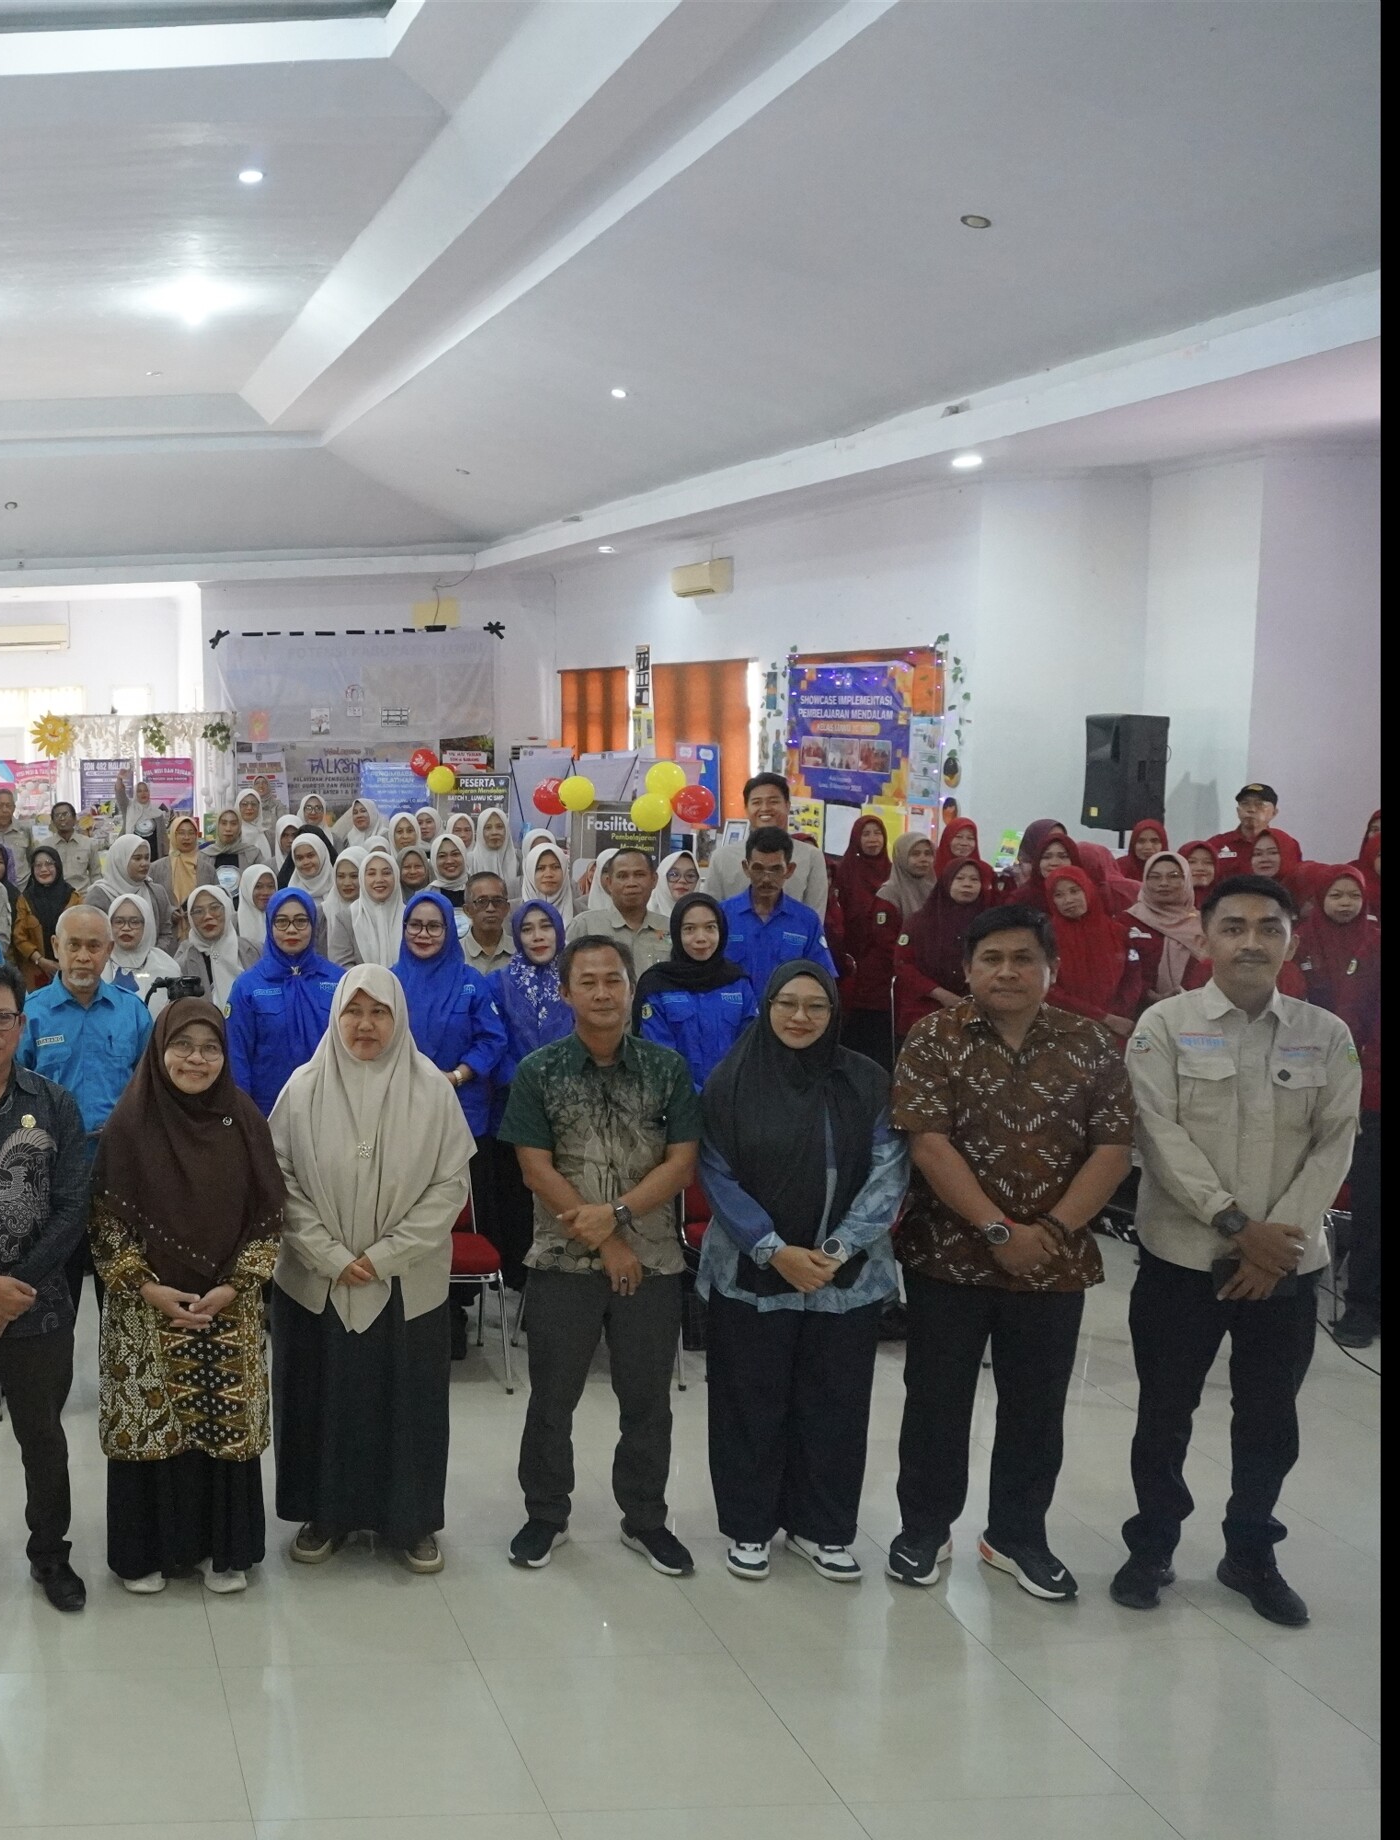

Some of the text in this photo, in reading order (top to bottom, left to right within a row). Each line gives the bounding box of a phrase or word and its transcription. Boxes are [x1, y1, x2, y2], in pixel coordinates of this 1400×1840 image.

[800, 695, 893, 706] SHOWCASE IMPLEMENTASI
[798, 708, 894, 720] PEMBELAJARAN MENDALAM
[308, 757, 389, 774] TALKSH
[460, 779, 496, 787] PESERTA
[587, 816, 642, 831] Fasilita
[611, 833, 657, 842] Pembelajaran
